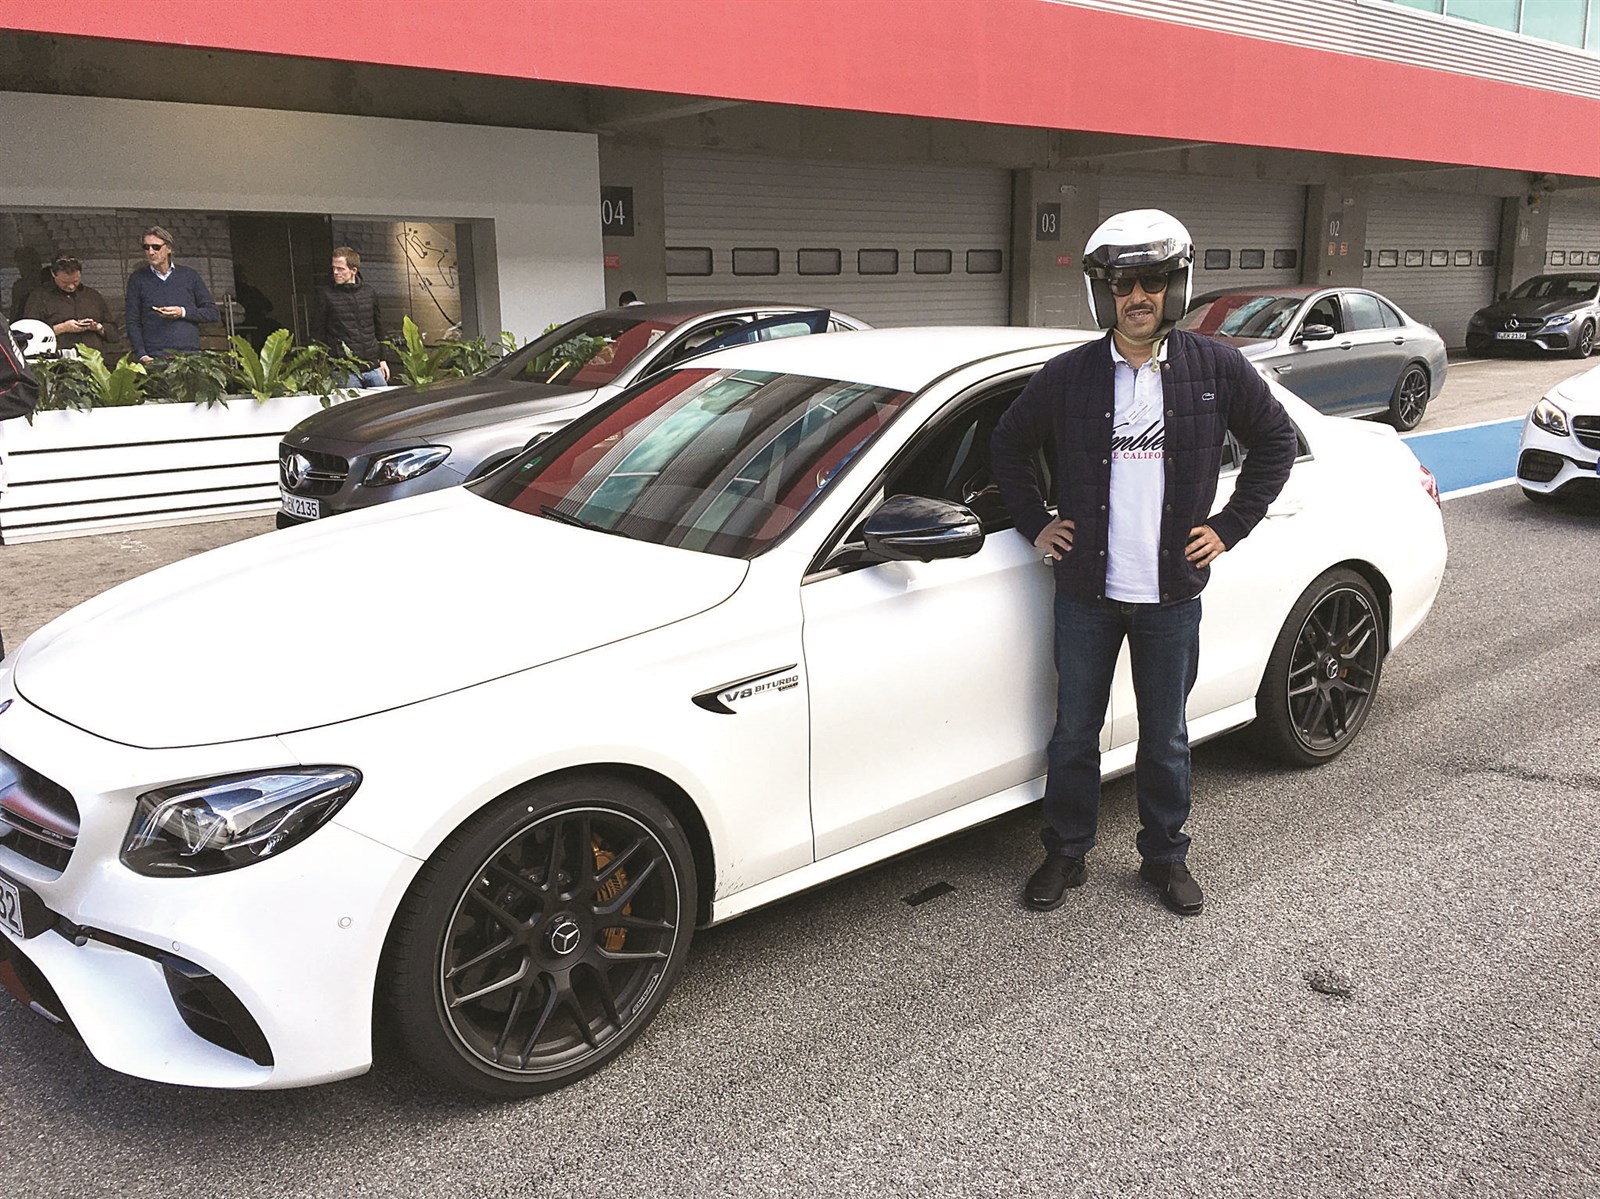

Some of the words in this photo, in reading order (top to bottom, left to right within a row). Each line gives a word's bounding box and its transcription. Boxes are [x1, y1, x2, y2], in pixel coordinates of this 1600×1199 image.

[602, 199, 626, 225] 04
[1042, 213, 1056, 233] 03
[1329, 220, 1340, 237] 02
[296, 499, 318, 517] 2135
[725, 688, 753, 702] V8
[755, 675, 799, 693] BITURBO
